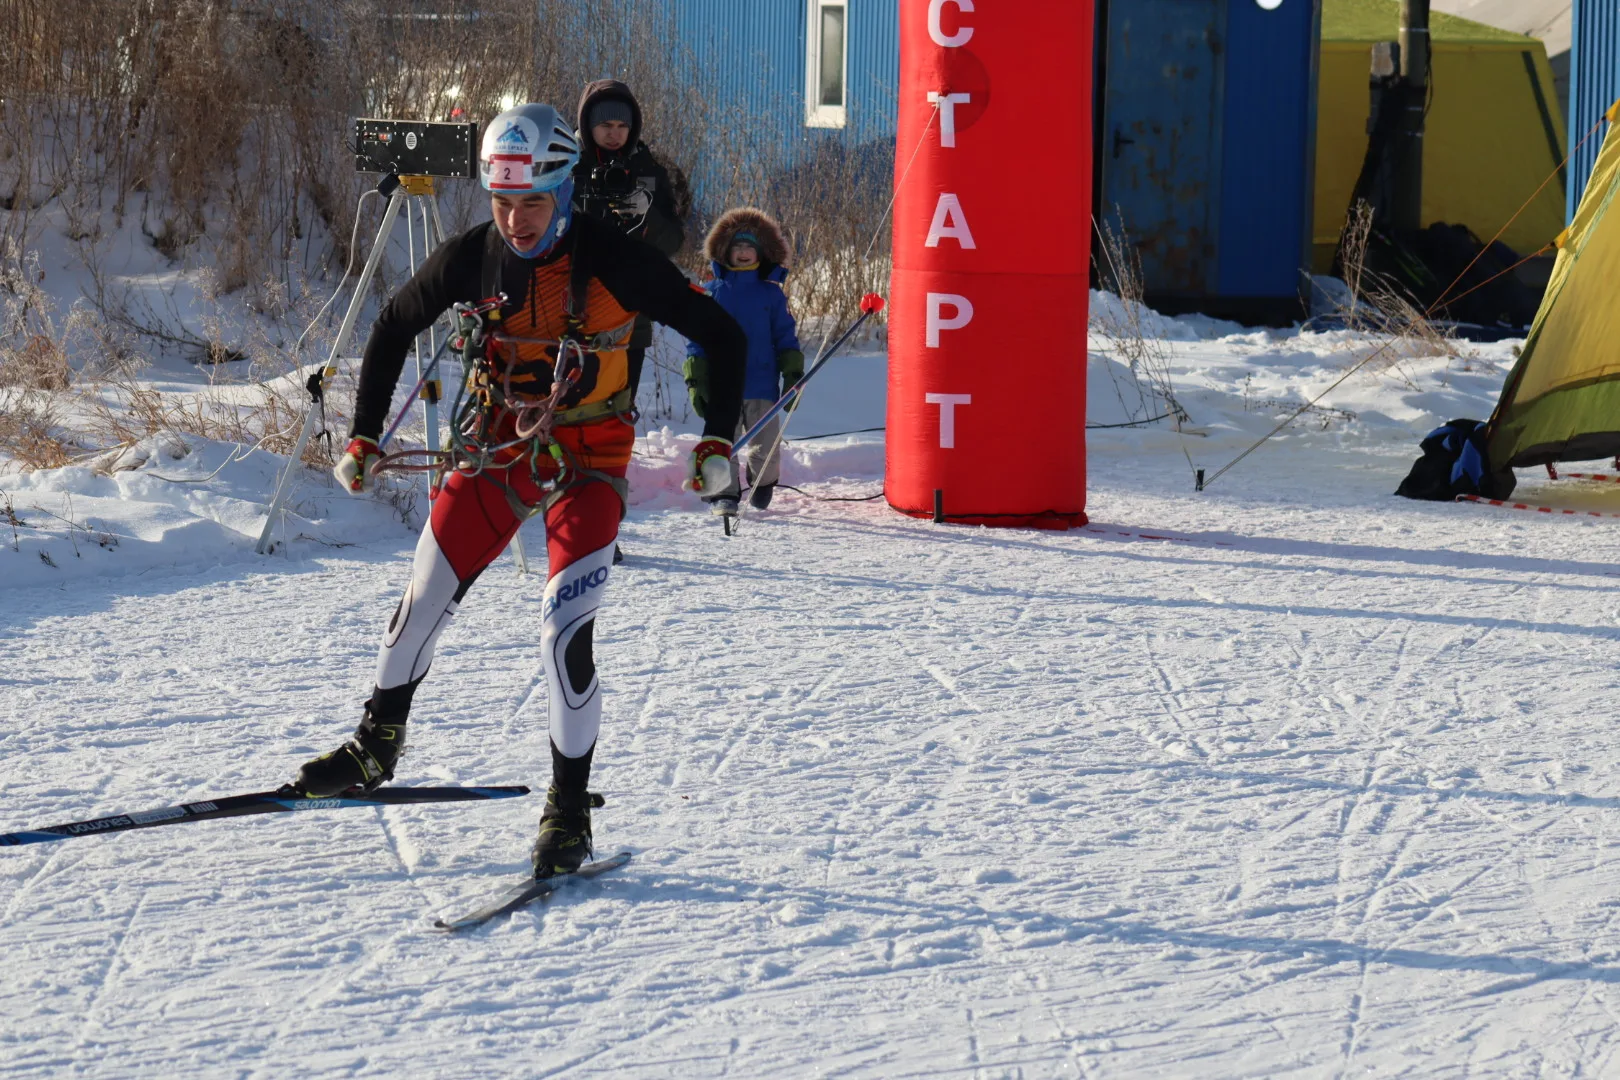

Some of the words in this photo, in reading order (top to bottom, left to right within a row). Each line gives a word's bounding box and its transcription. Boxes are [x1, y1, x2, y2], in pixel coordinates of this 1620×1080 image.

[503, 167, 511, 180] 2
[924, 0, 977, 449] СТАРТ
[543, 565, 608, 623] BRIKO
[294, 799, 341, 810] salomon
